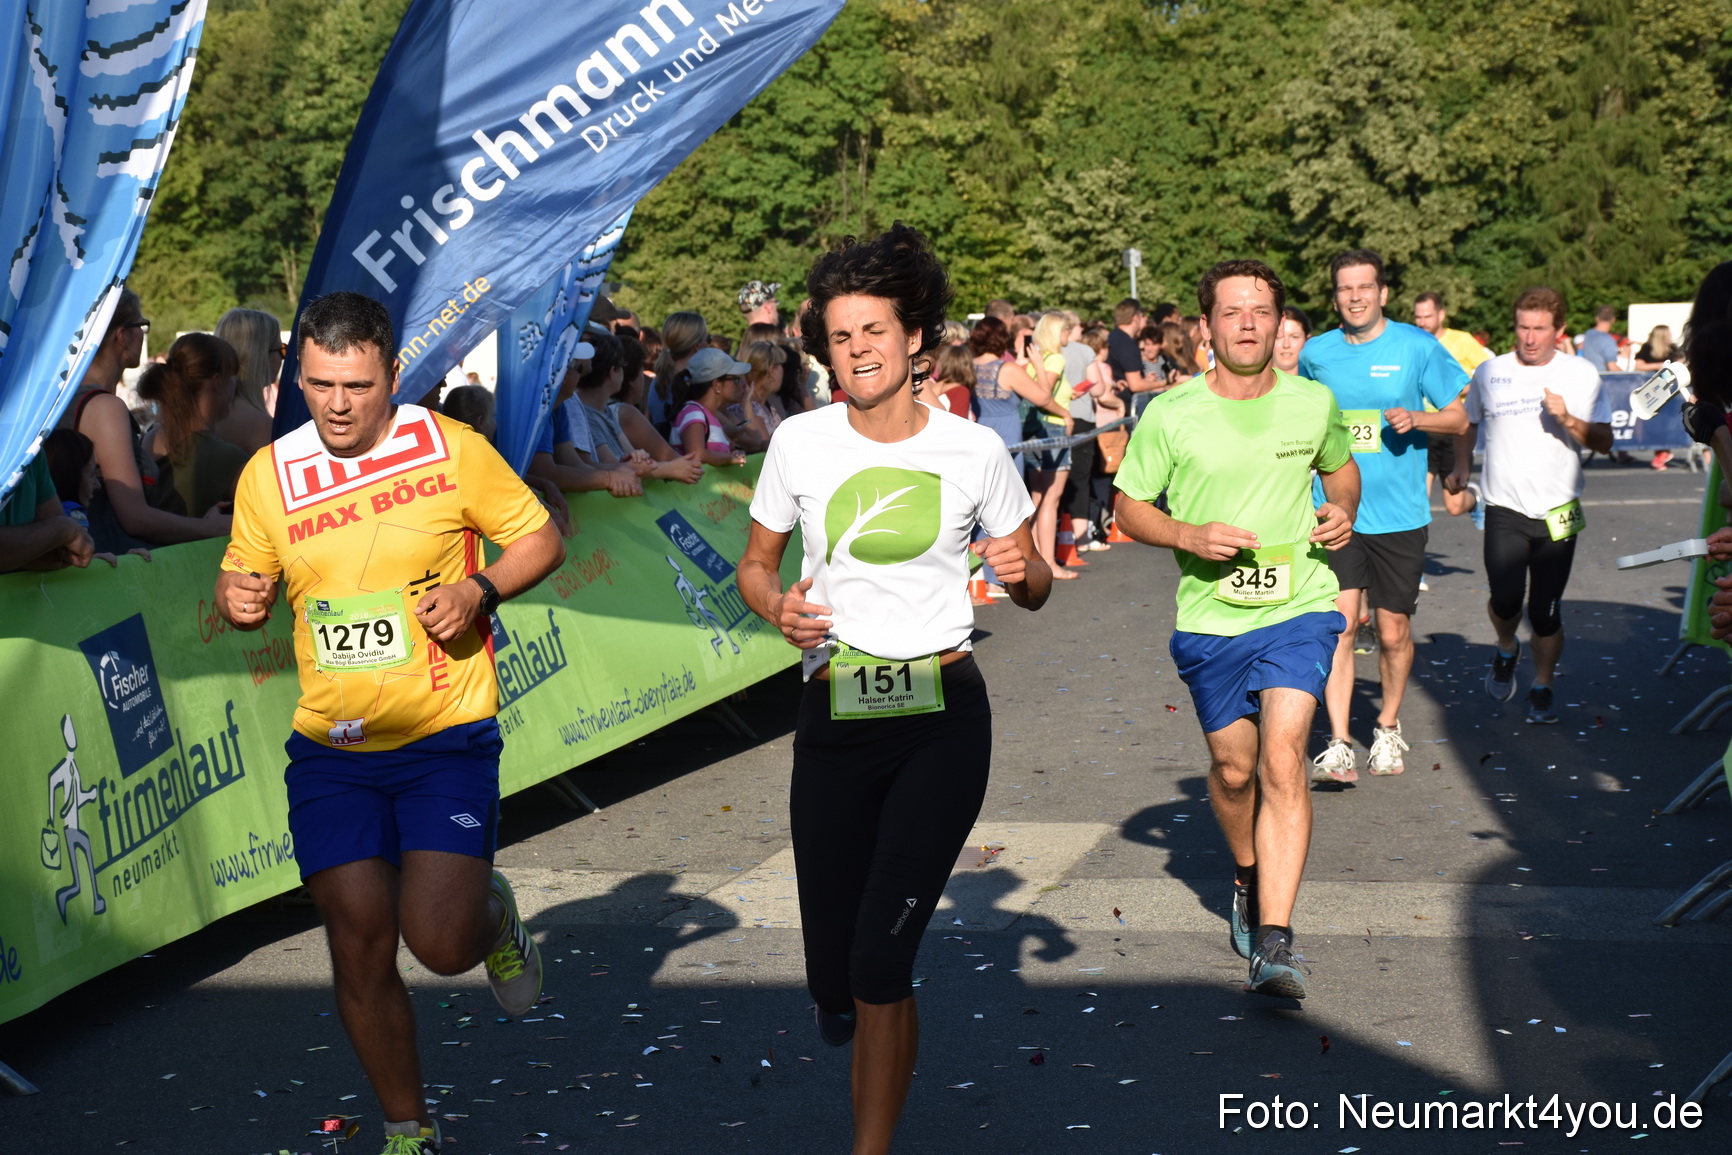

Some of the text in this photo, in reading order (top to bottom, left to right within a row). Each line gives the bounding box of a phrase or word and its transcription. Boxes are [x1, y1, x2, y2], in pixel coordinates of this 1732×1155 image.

[580, 0, 775, 154] Druck und Me
[351, 0, 695, 294] Frischmann
[399, 276, 492, 374] nn-net.de
[1347, 425, 1373, 441] 23
[1275, 450, 1298, 459] SMART
[287, 472, 457, 545] MAX BÖGL
[1230, 567, 1278, 590] 345
[1233, 588, 1275, 596] Müller Martin
[318, 619, 394, 651] 1279
[332, 648, 385, 661] Dabija Ovidiu
[378, 654, 397, 663] GmbH
[497, 607, 568, 709] enlauf
[110, 663, 150, 701] Fischer
[853, 662, 912, 695] 151
[122, 687, 152, 713] AUTOMOBILE
[557, 664, 697, 747] www.firmenlauf-oberpfalz.de
[858, 693, 914, 705] Halser Katrin
[98, 699, 245, 866] firmenlauf
[113, 829, 181, 898] neumarkt
[890, 906, 913, 936] Reebok
